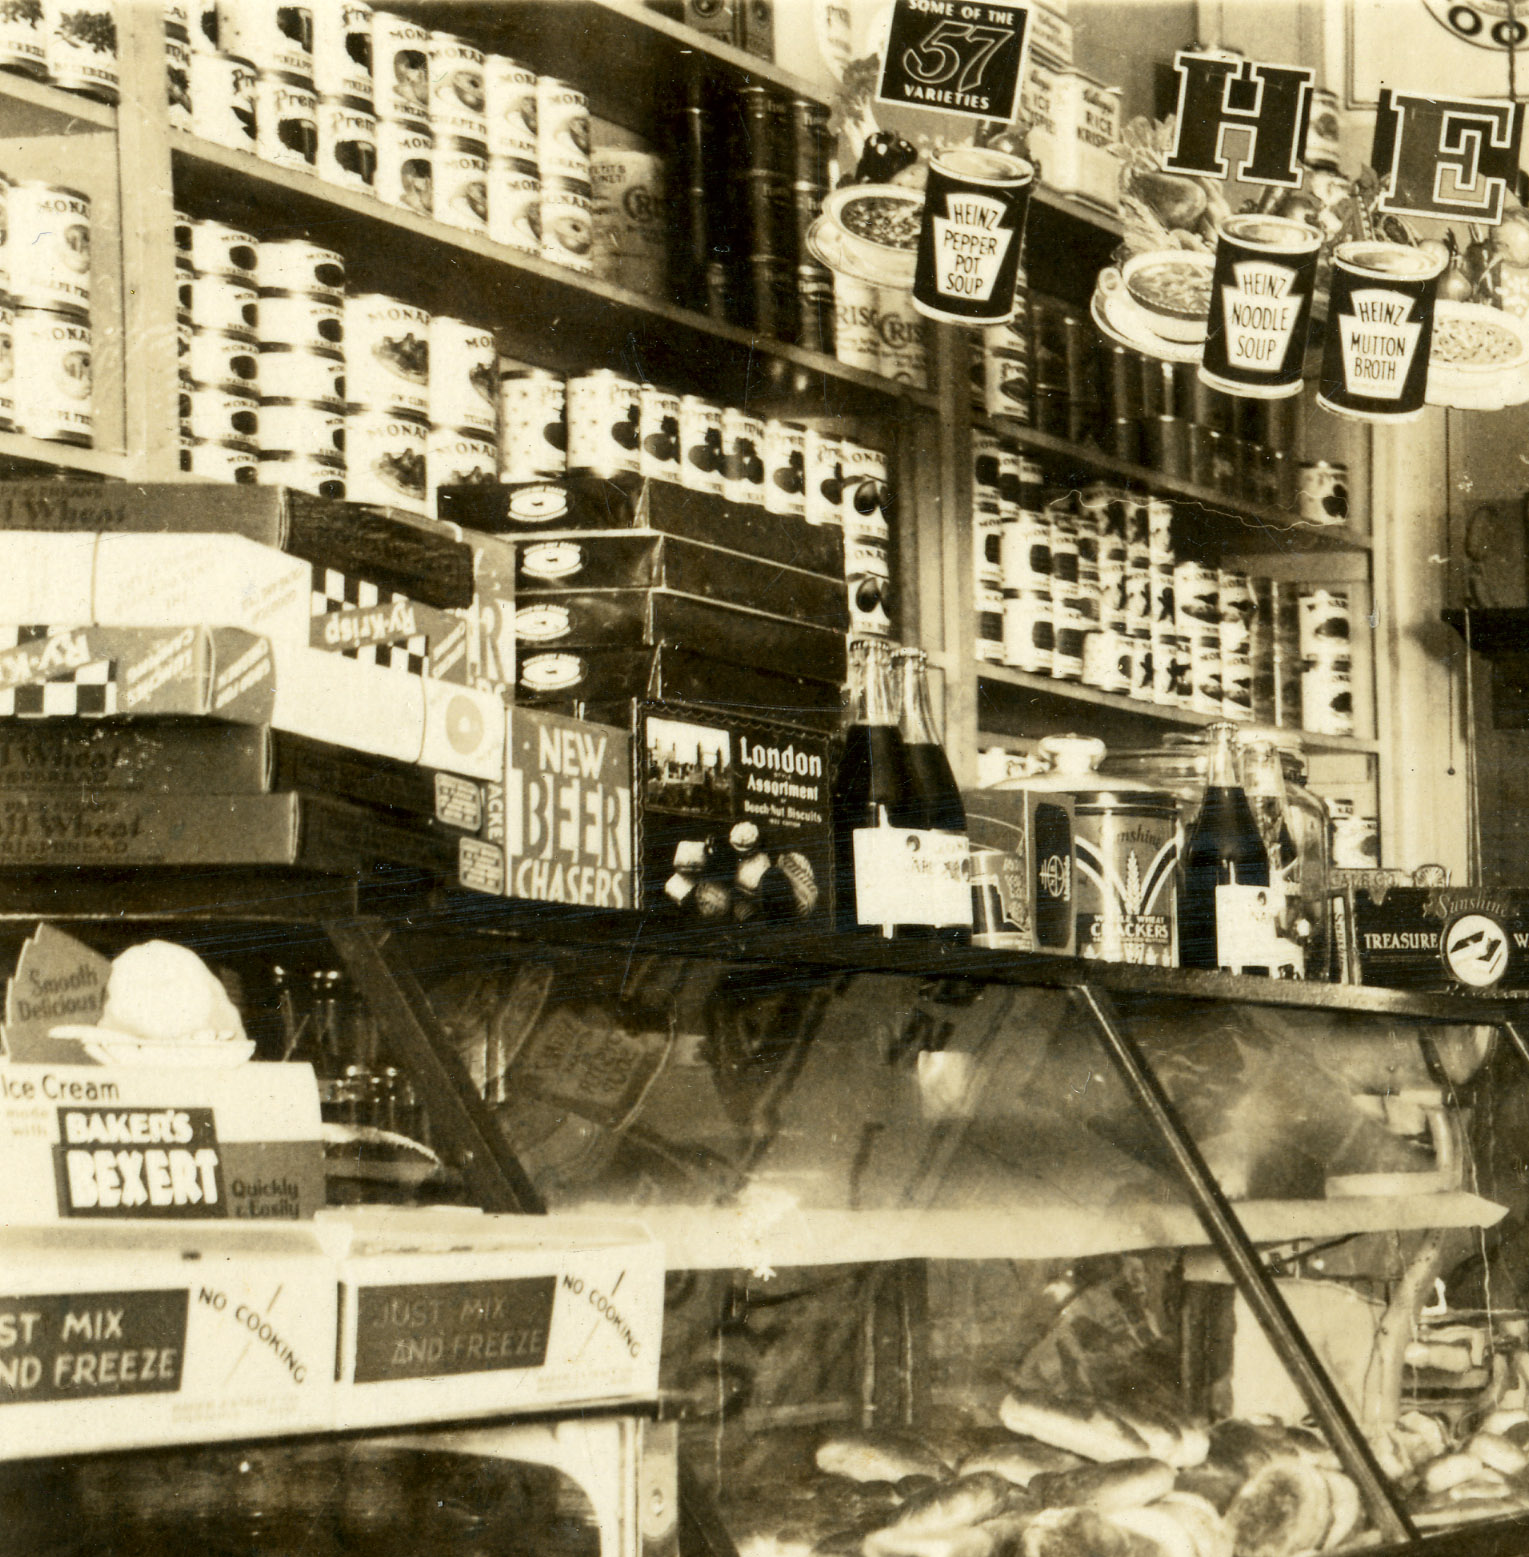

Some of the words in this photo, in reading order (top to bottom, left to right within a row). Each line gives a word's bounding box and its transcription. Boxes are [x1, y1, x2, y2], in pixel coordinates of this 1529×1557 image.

[908, 0, 955, 17] SOME
[961, 5, 982, 21] OF
[987, 10, 1015, 26] THE
[903, 20, 1016, 93] 57
[903, 82, 991, 111] VARIETIES
[953, 203, 1000, 231] HEINZ
[943, 228, 998, 256] PEPPER
[954, 253, 981, 276] POT
[945, 272, 984, 296] SOUP
[1242, 272, 1287, 299] HEINZ
[1231, 301, 1289, 332] NOODLE
[1359, 301, 1405, 328] HEINZ
[1236, 335, 1277, 362] SOUP
[1350, 330, 1407, 357] MUTTON
[1354, 355, 1397, 381] BROTH
[539, 725, 607, 780] NEW
[739, 735, 823, 778] London
[747, 773, 819, 801] Assortment
[522, 771, 629, 872] BEER
[515, 857, 625, 910] CHASERS
[1090, 921, 1169, 940] CACKERS
[1363, 931, 1440, 950] TREASURE
[28, 961, 99, 998] Smooth
[1, 1073, 36, 1100] Ice
[41, 1073, 120, 1101] Cream
[64, 1109, 194, 1144] BAKER'S
[65, 1147, 219, 1208] BEXERT
[231, 1177, 299, 1200] Quickly
[60, 1308, 125, 1343] MIX
[372, 1299, 441, 1329] JUST
[460, 1296, 508, 1322] MIX
[562, 1274, 585, 1296] NO
[588, 1288, 642, 1360] COOKING
[199, 1286, 228, 1311] NO
[235, 1304, 308, 1385] COOKING
[391, 1335, 443, 1365] AND
[452, 1327, 543, 1358] FREEZE
[53, 1347, 179, 1389] FREEZE
